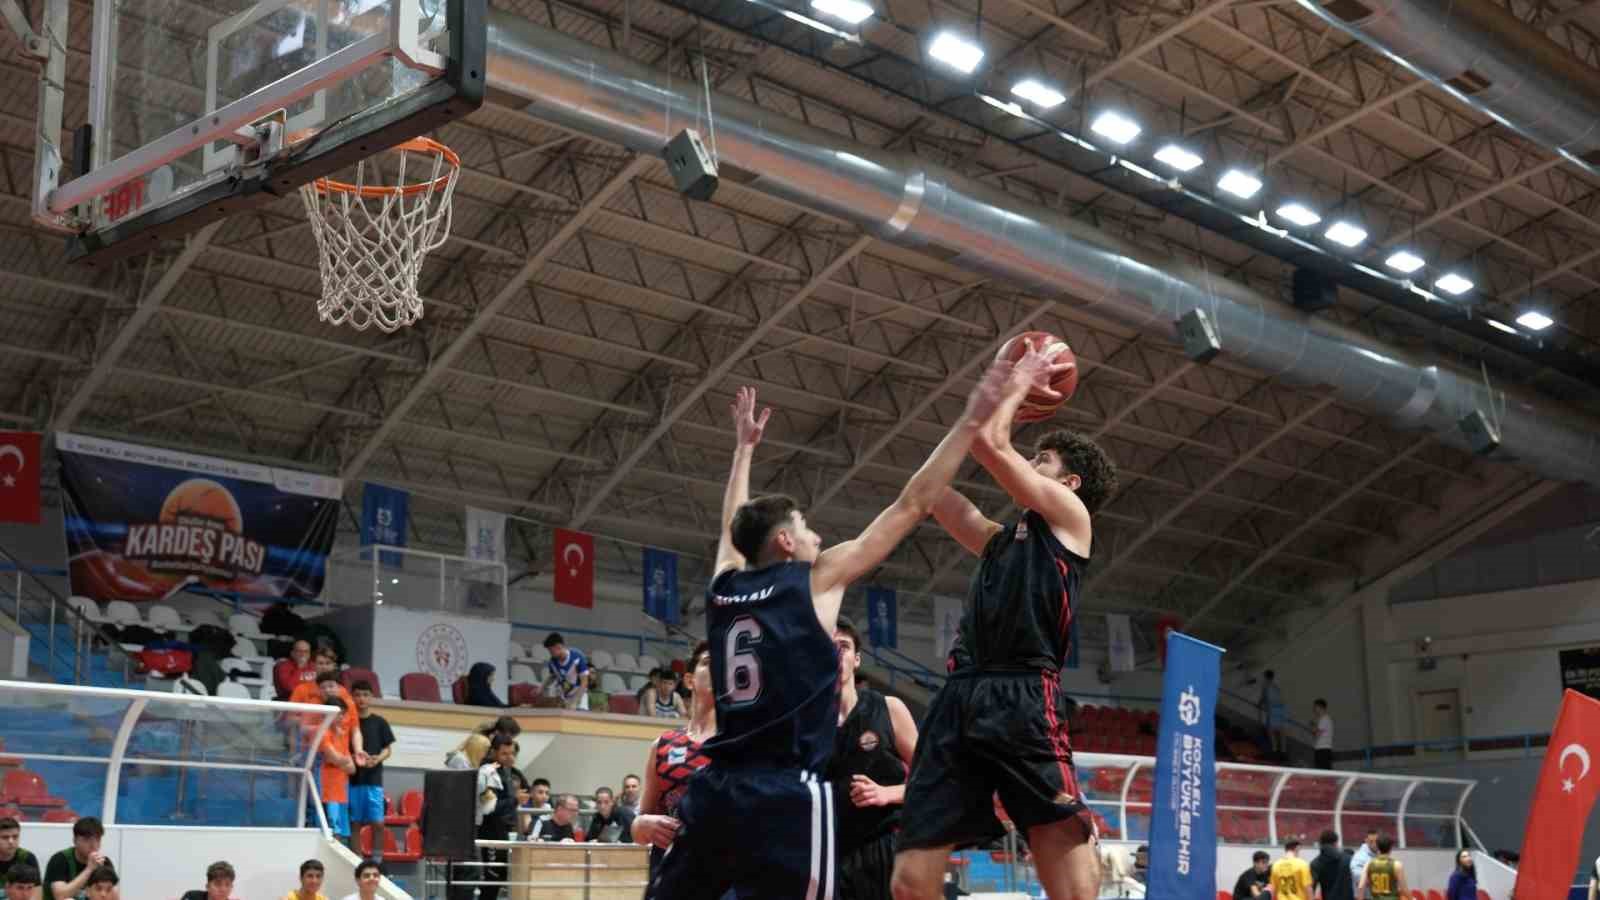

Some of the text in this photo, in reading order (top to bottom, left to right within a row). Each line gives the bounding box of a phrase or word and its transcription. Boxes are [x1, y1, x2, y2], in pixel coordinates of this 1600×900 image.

[126, 526, 216, 563] KARDEŞ
[220, 534, 265, 573] PASI
[727, 615, 763, 704] 6
